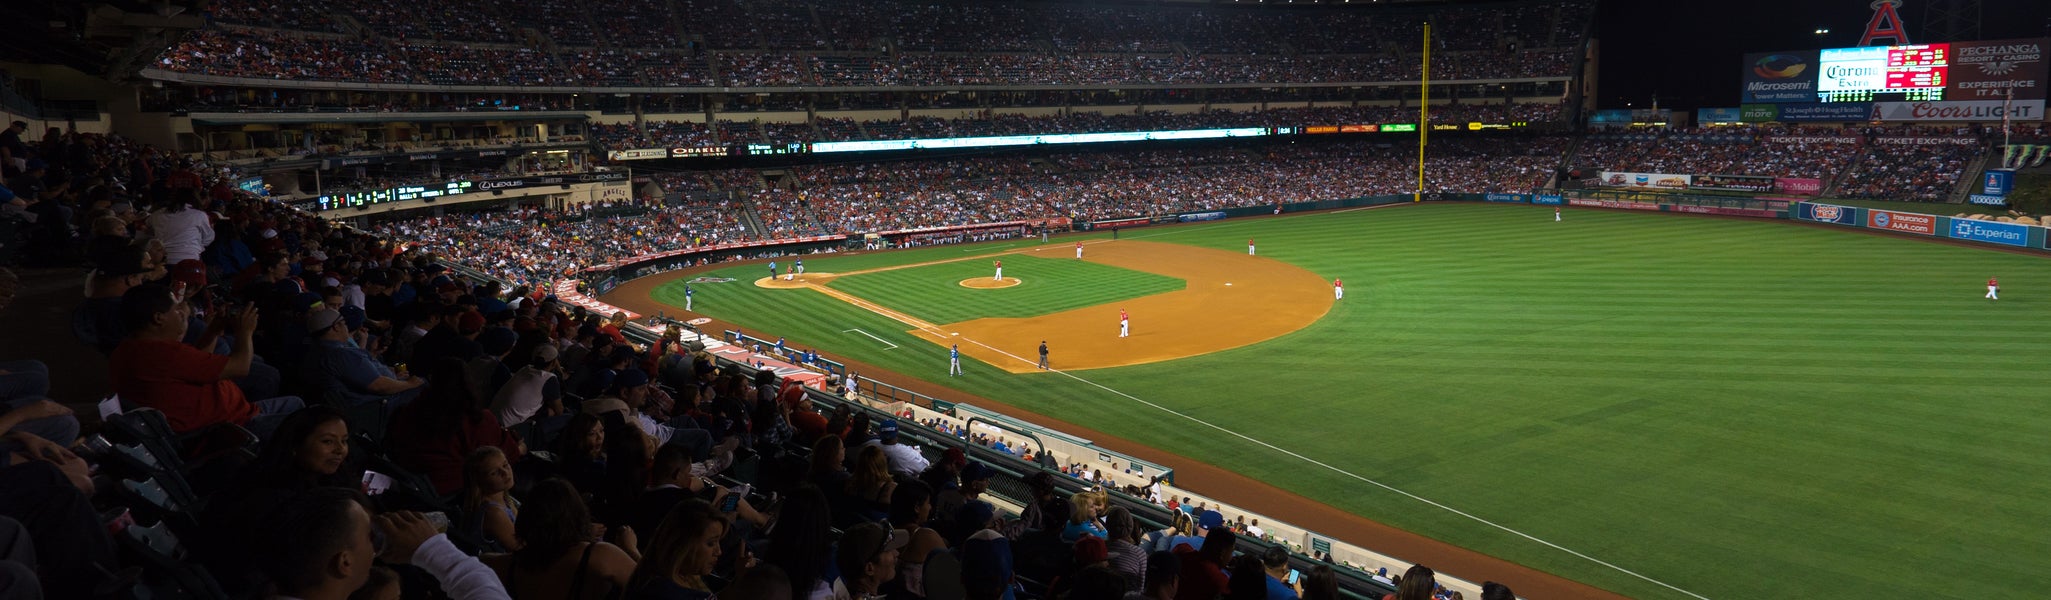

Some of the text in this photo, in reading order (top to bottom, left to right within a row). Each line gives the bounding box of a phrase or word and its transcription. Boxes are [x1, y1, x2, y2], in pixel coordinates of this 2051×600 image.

[1959, 44, 2040, 61] PECHANGA
[1827, 65, 1878, 80] Corona
[1747, 80, 1811, 91] Microsemi
[1839, 78, 1869, 87] Extra
[1958, 80, 2035, 89] EXPERIENCE
[1912, 102, 2032, 118] Coors LIGHT
[491, 180, 523, 188] LEXUS
[603, 188, 625, 197] ANGELS
[1892, 213, 1929, 224] Insurance
[1891, 222, 1928, 233] AAA.com
[1974, 226, 2020, 241] Experian
